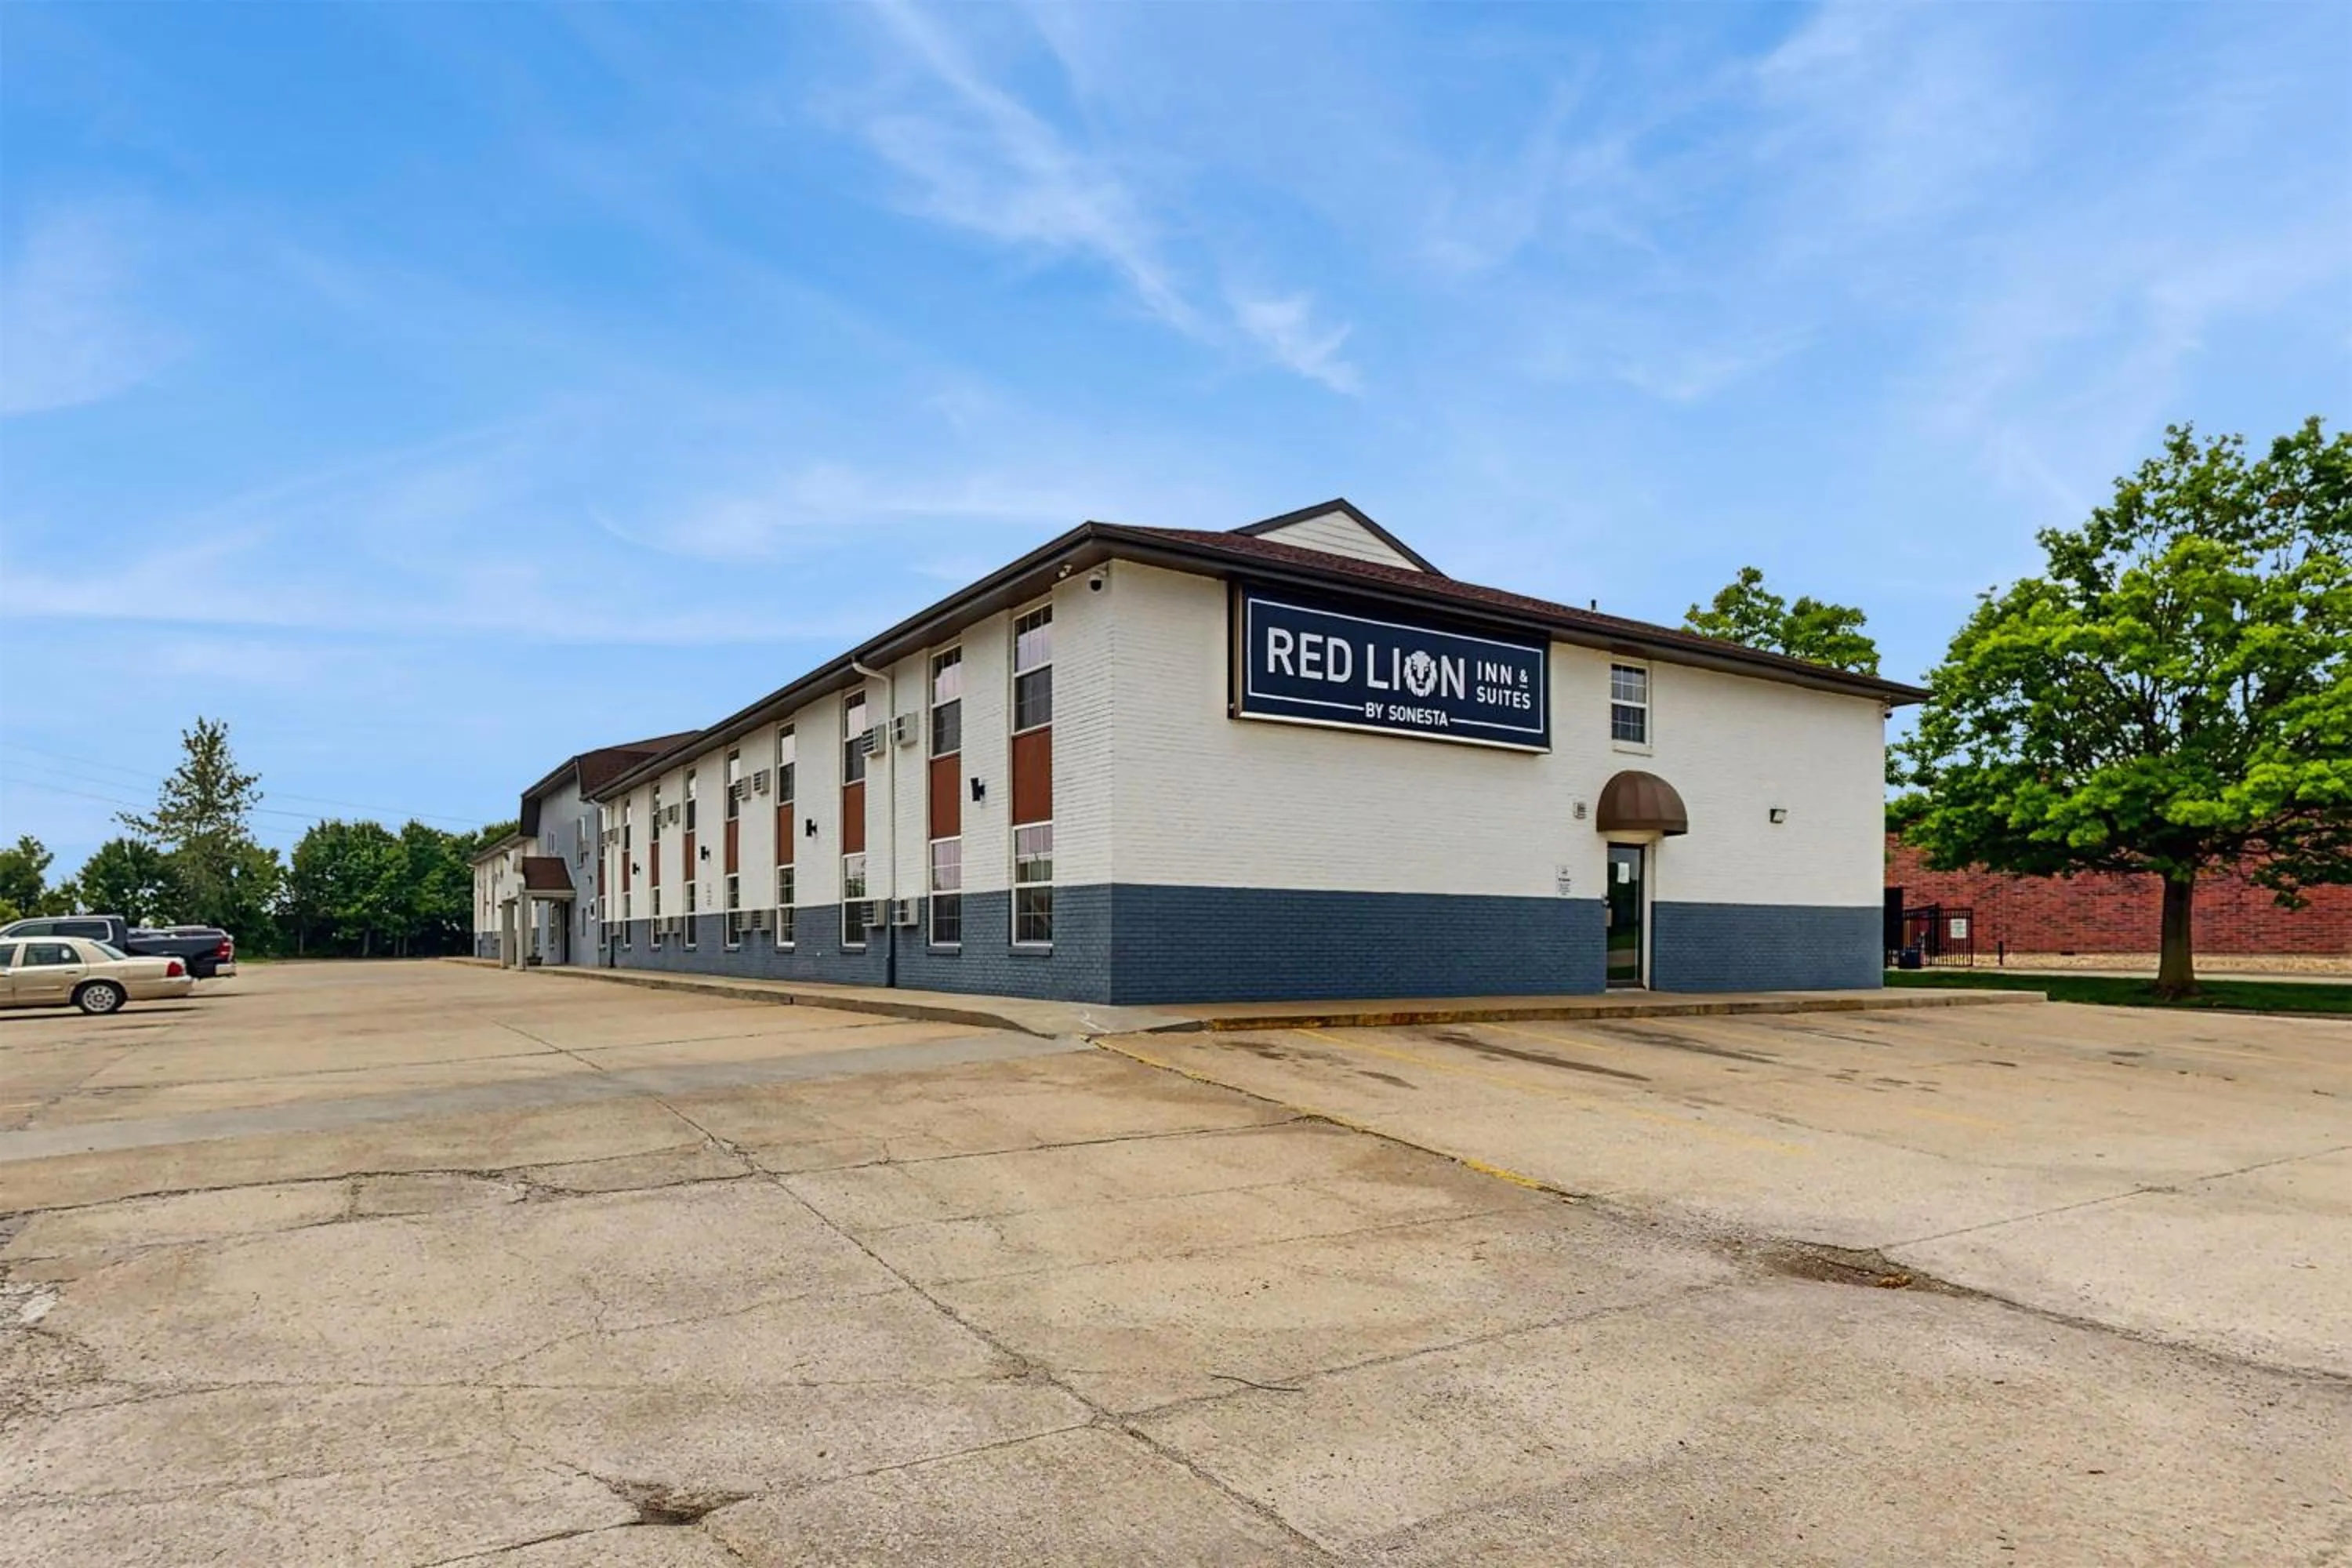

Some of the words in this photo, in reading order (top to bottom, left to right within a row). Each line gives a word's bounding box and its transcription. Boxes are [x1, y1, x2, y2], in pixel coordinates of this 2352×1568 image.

[1267, 626, 1353, 683] RED
[1367, 644, 1466, 700] LION
[1476, 660, 1513, 685] INN
[1519, 668, 1529, 684] &
[1476, 685, 1532, 710] SUITES
[1364, 702, 1384, 719] BY
[1388, 705, 1449, 727] SONESTA
